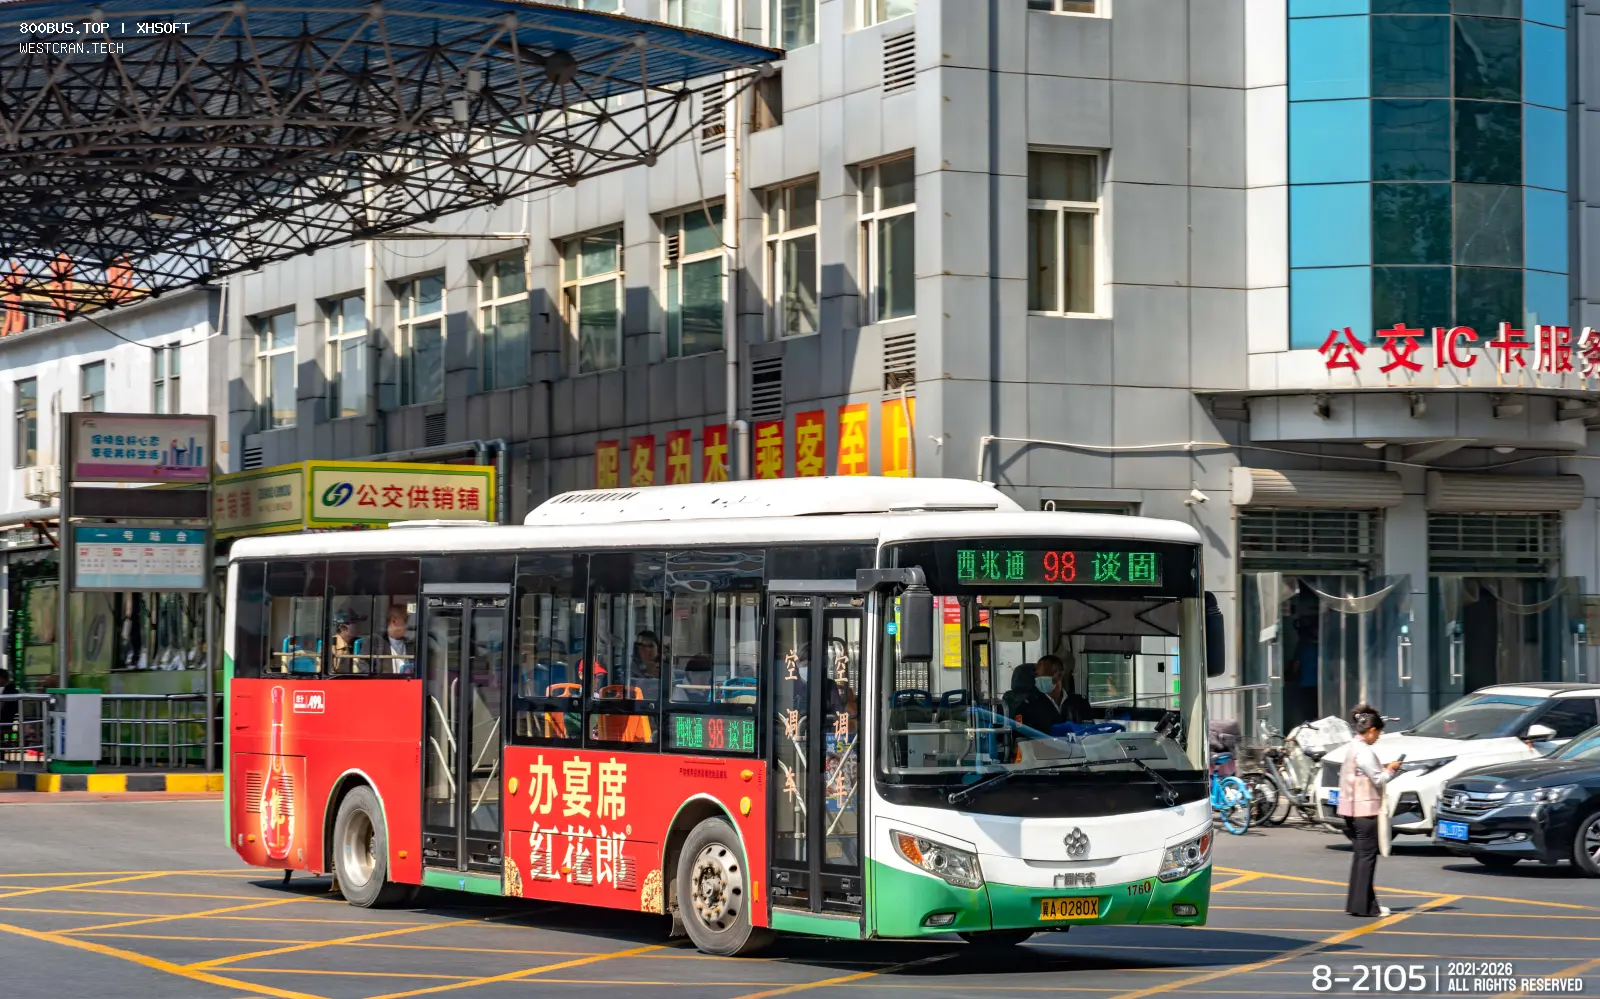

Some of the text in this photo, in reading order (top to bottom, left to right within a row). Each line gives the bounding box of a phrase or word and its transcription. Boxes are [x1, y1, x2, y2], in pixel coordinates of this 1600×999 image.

[356, 484, 480, 511] 公交供销铺
[957, 549, 1155, 583] 西兆通 98 谈固
[675, 716, 755, 752] 西兆通 98 谈固
[783, 649, 799, 803] 空调车
[832, 651, 849, 808] 空调车
[528, 755, 627, 820] 办宴席
[529, 821, 627, 889] 红花郎
[1127, 880, 1151, 896] 1760
